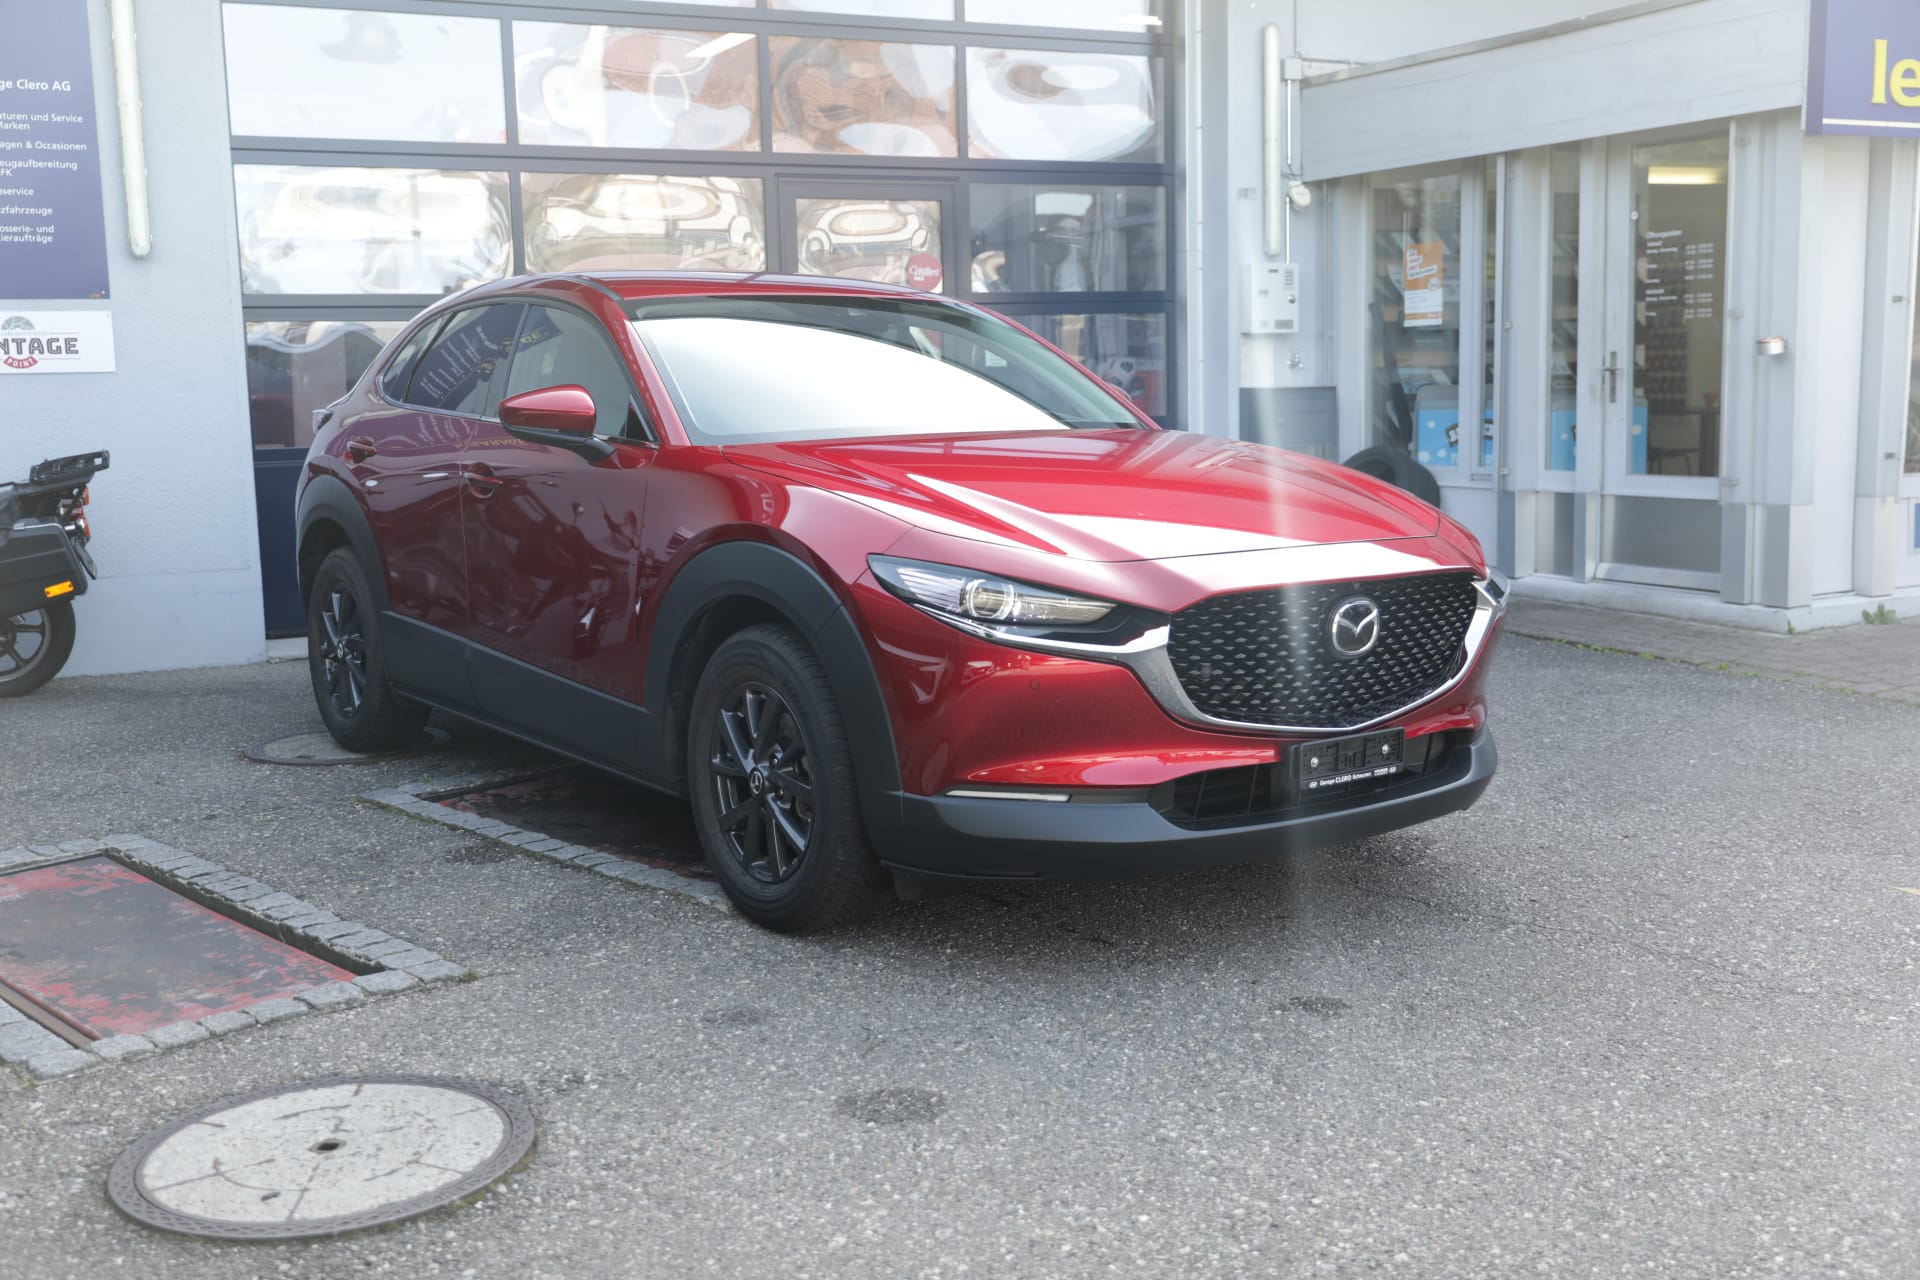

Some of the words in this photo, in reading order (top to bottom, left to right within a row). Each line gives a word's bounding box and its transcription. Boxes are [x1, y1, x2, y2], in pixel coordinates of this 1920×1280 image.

[16, 79, 49, 91] Clero
[52, 80, 71, 91] AG
[30, 113, 49, 121] und
[51, 113, 84, 123] Service
[25, 141, 33, 149] &
[35, 141, 87, 151] Occasionen
[0, 205, 53, 217] zfahrzeuge
[36, 225, 55, 233] und
[0, 234, 53, 244] ieraufträge
